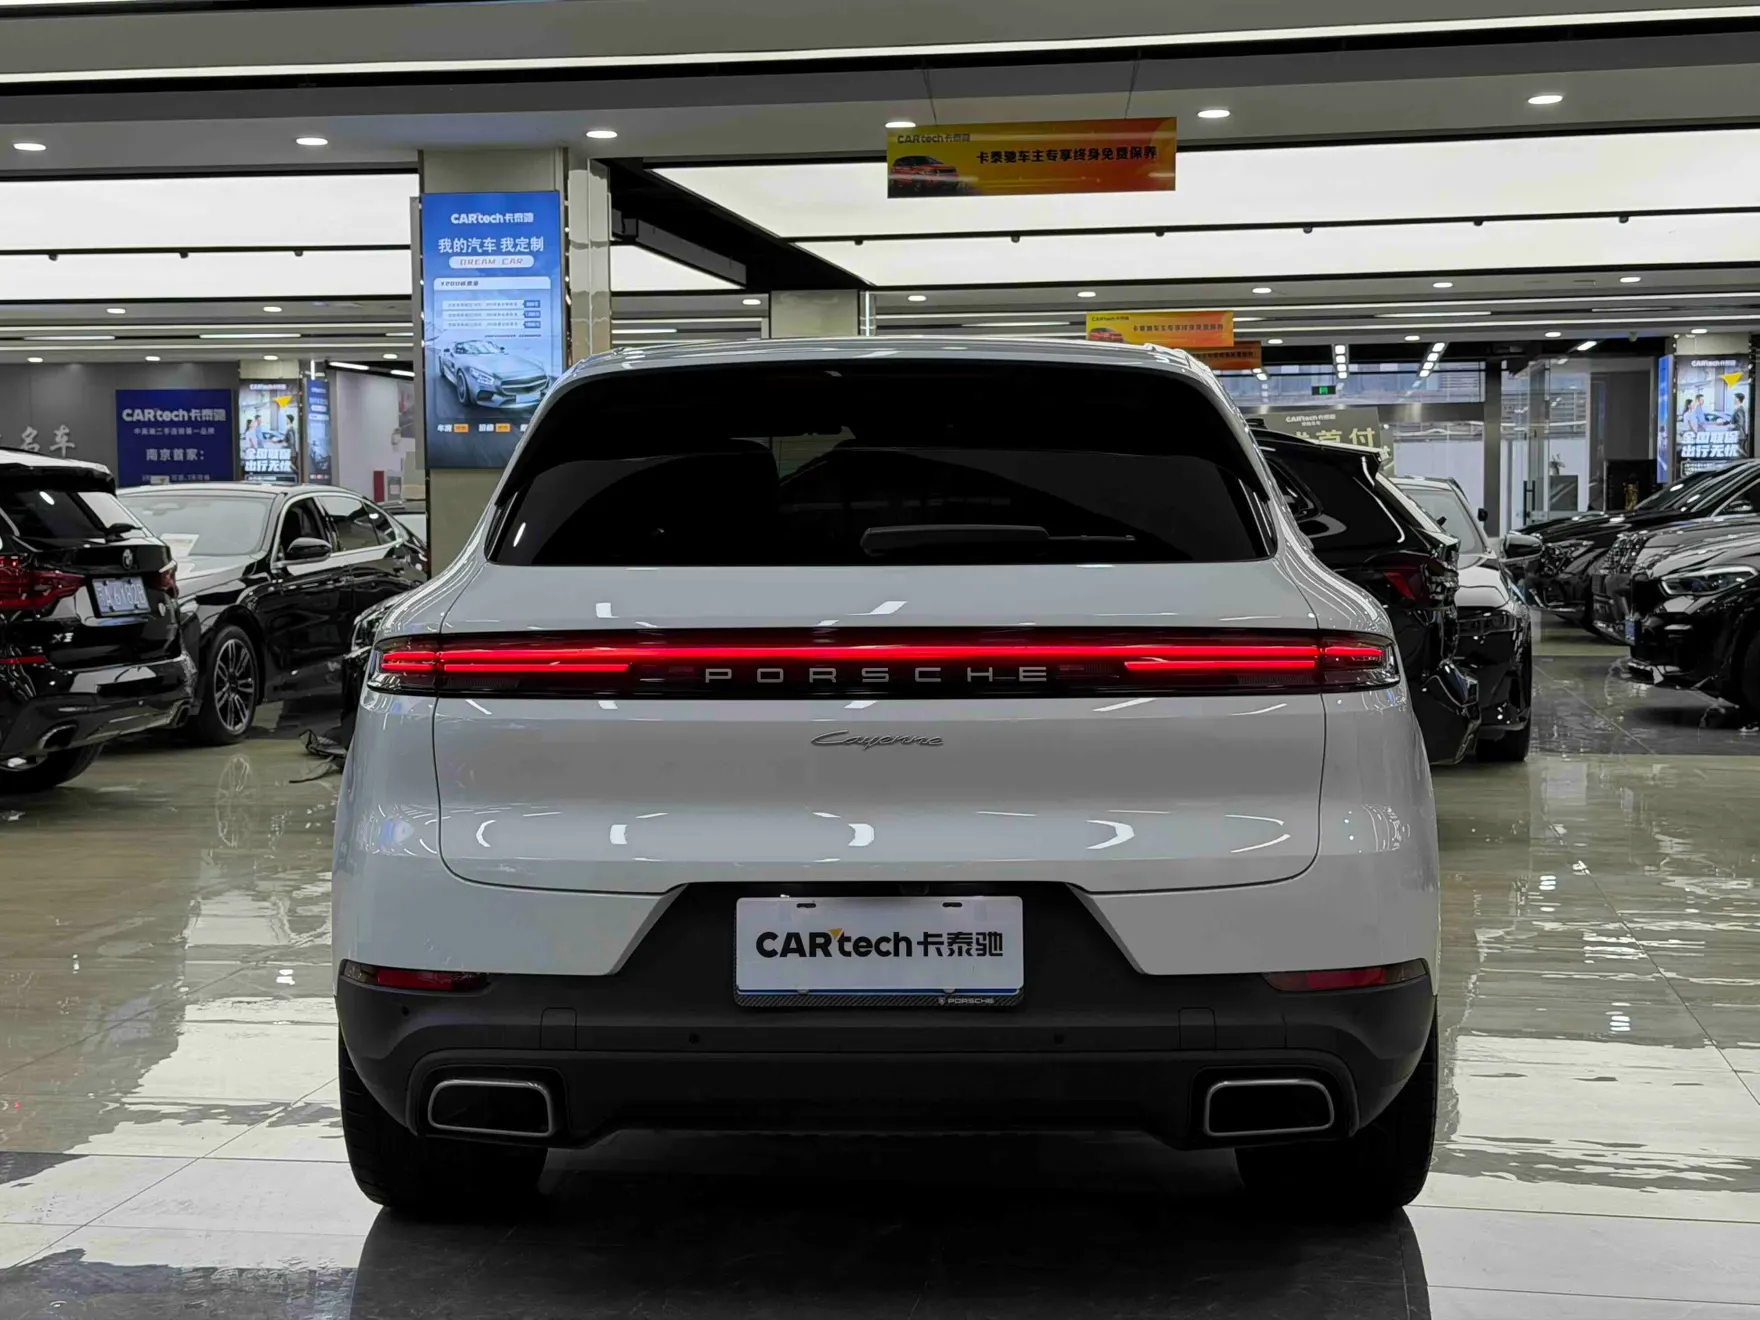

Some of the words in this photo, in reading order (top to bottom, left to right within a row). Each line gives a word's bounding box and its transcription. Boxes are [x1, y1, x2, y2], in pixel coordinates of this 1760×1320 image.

[438, 237, 497, 253] 我的汽车
[500, 236, 544, 252] 我定制
[460, 258, 496, 266] DREAM
[501, 257, 524, 265] CAR
[705, 667, 1047, 683] PORSCHE
[811, 730, 944, 750] Cayenne
